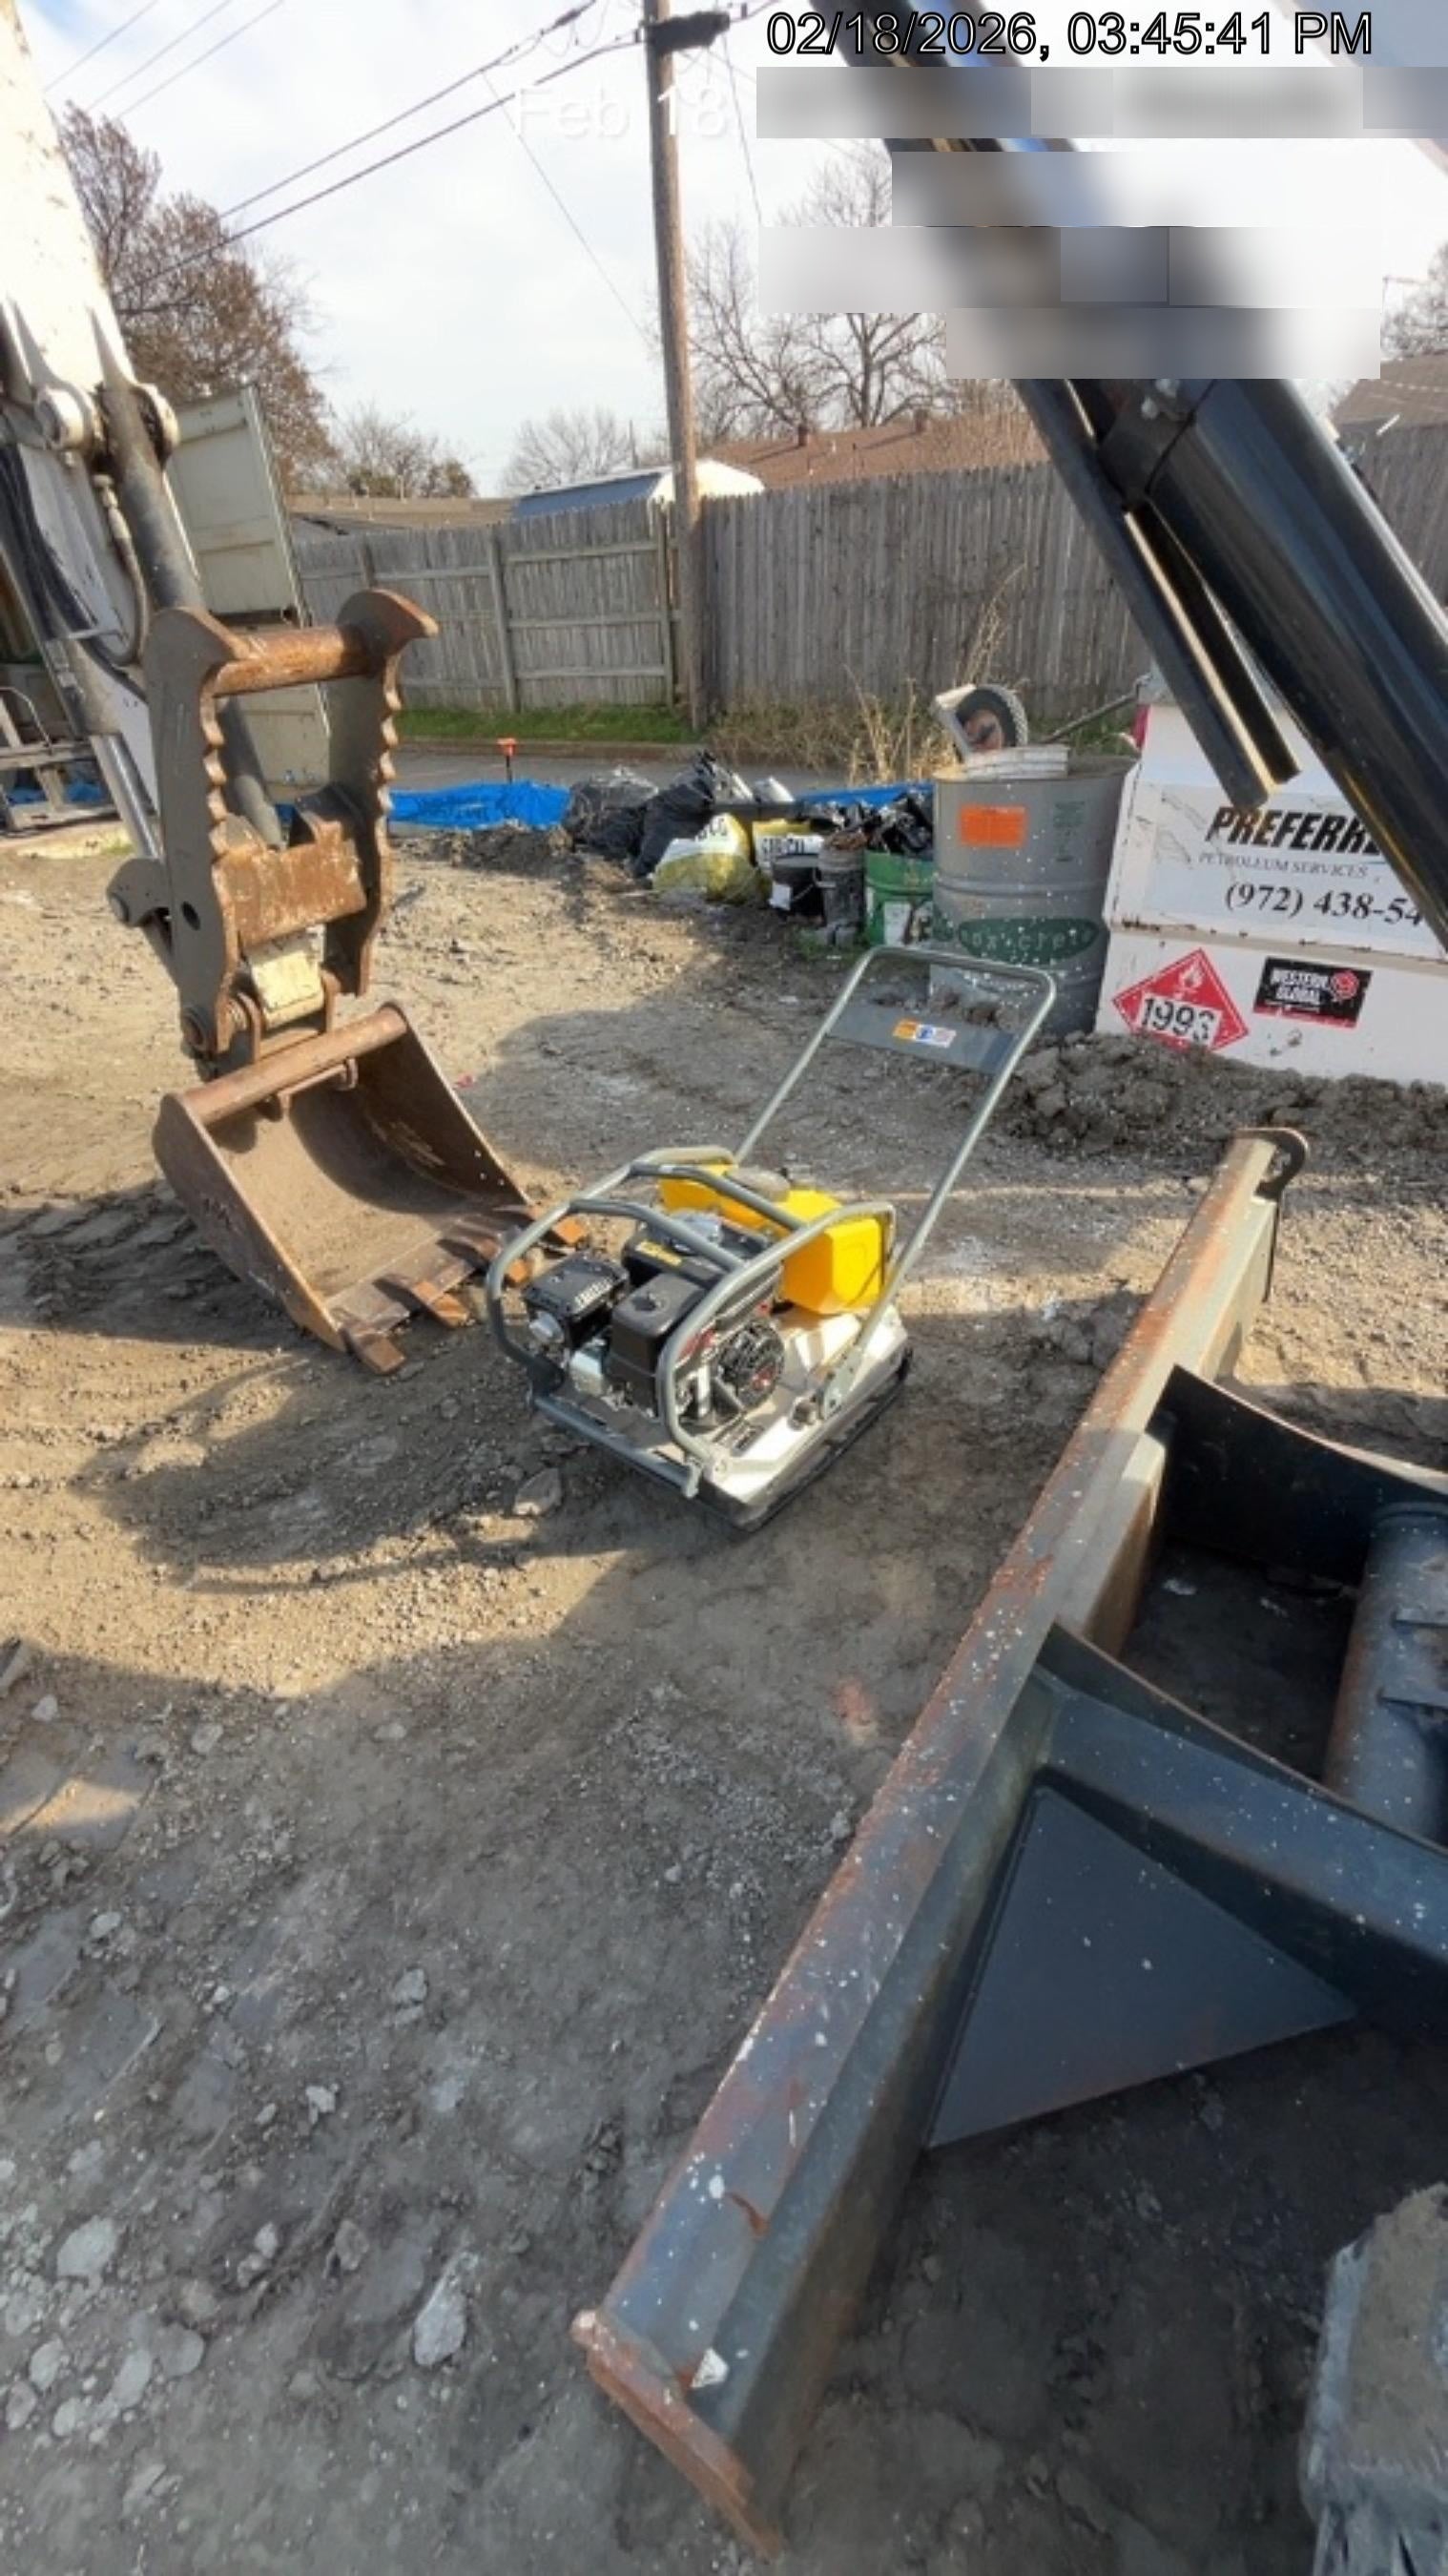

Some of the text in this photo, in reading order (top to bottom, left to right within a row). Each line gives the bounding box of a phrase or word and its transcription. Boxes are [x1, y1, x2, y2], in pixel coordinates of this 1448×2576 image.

[1205, 806, 1381, 856] PREFERR
[1199, 853, 1368, 879] PETROLEUM SERVICES
[1225, 883, 1304, 920] (972)
[1142, 997, 1215, 1042] 1993
